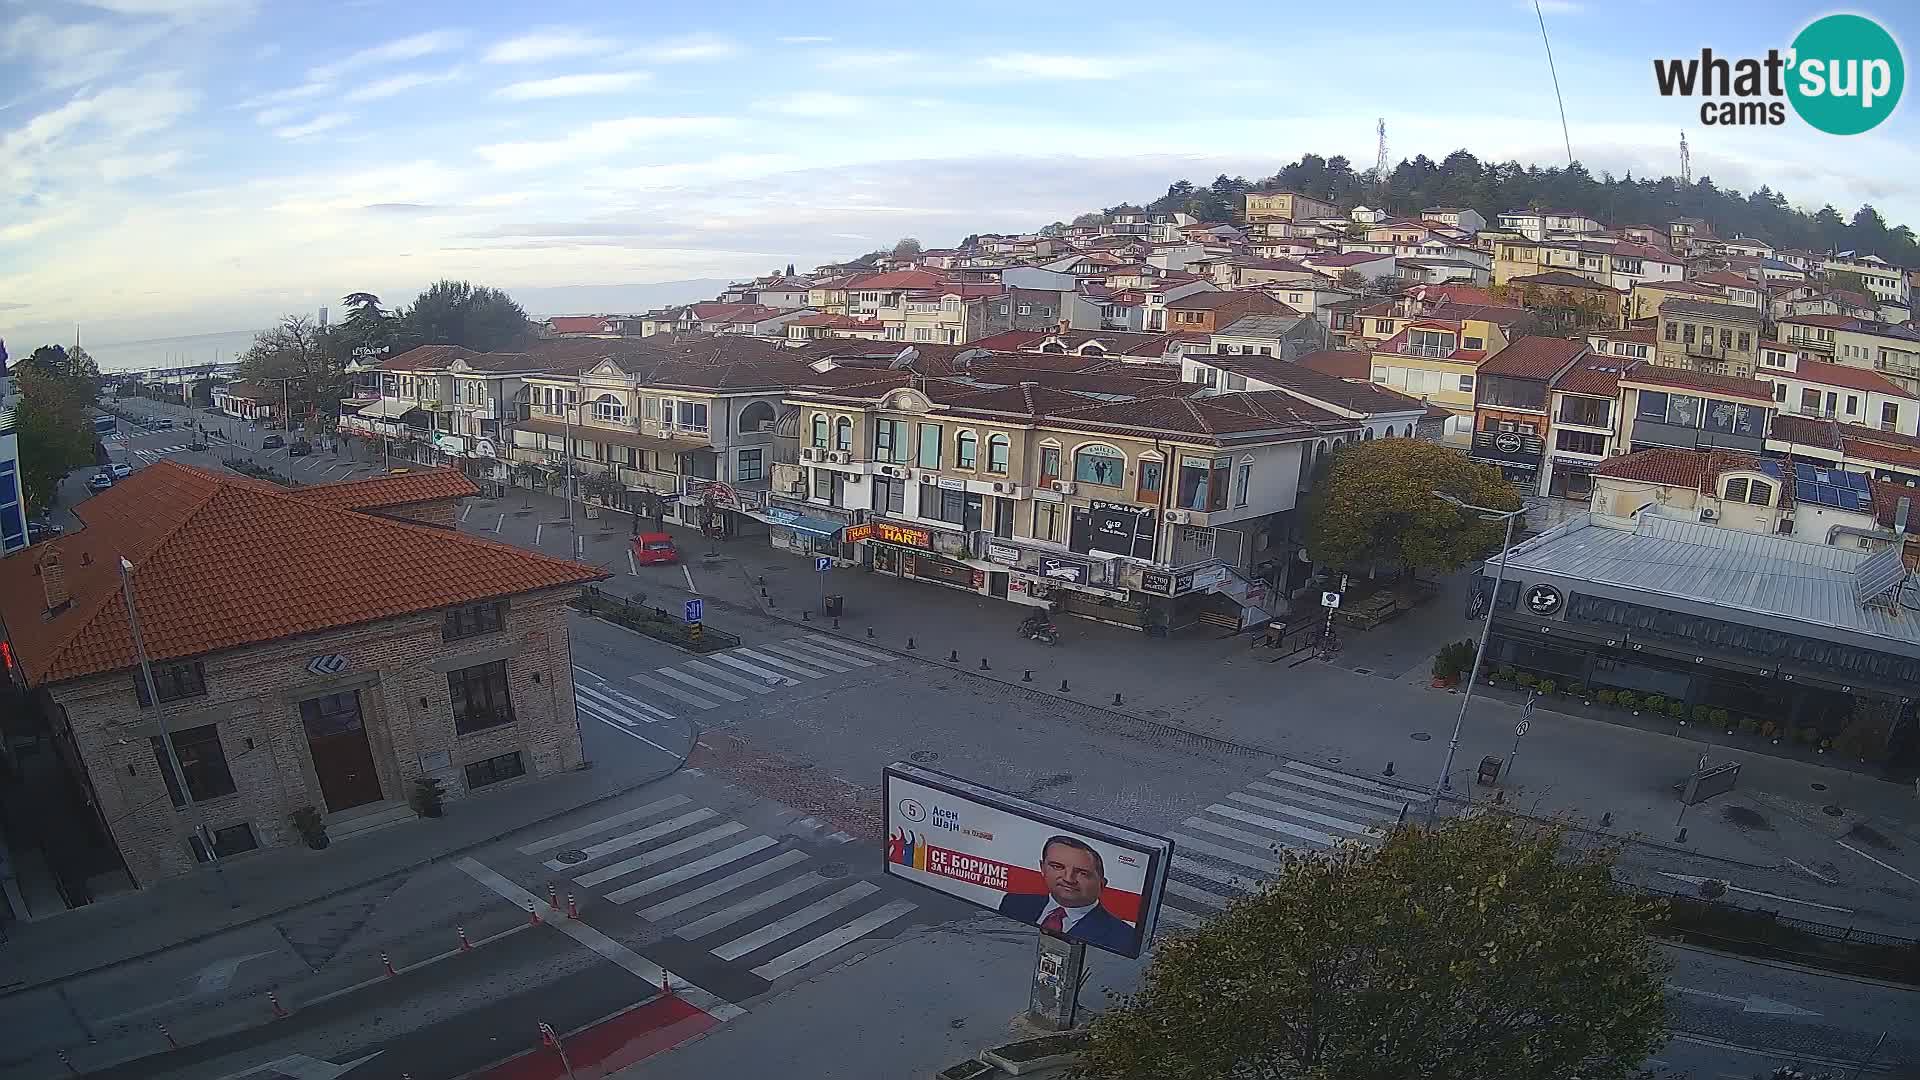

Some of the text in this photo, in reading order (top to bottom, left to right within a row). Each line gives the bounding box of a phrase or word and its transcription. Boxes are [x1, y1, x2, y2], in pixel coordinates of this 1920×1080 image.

[885, 529, 917, 545] HARI
[908, 804, 917, 817] 5
[932, 805, 959, 821] Асен
[932, 816, 960, 832] Шајн
[931, 850, 1009, 880] СЕ БОРИМЕ
[931, 862, 1008, 889] ЗА НАШИОТ ДОМ!
